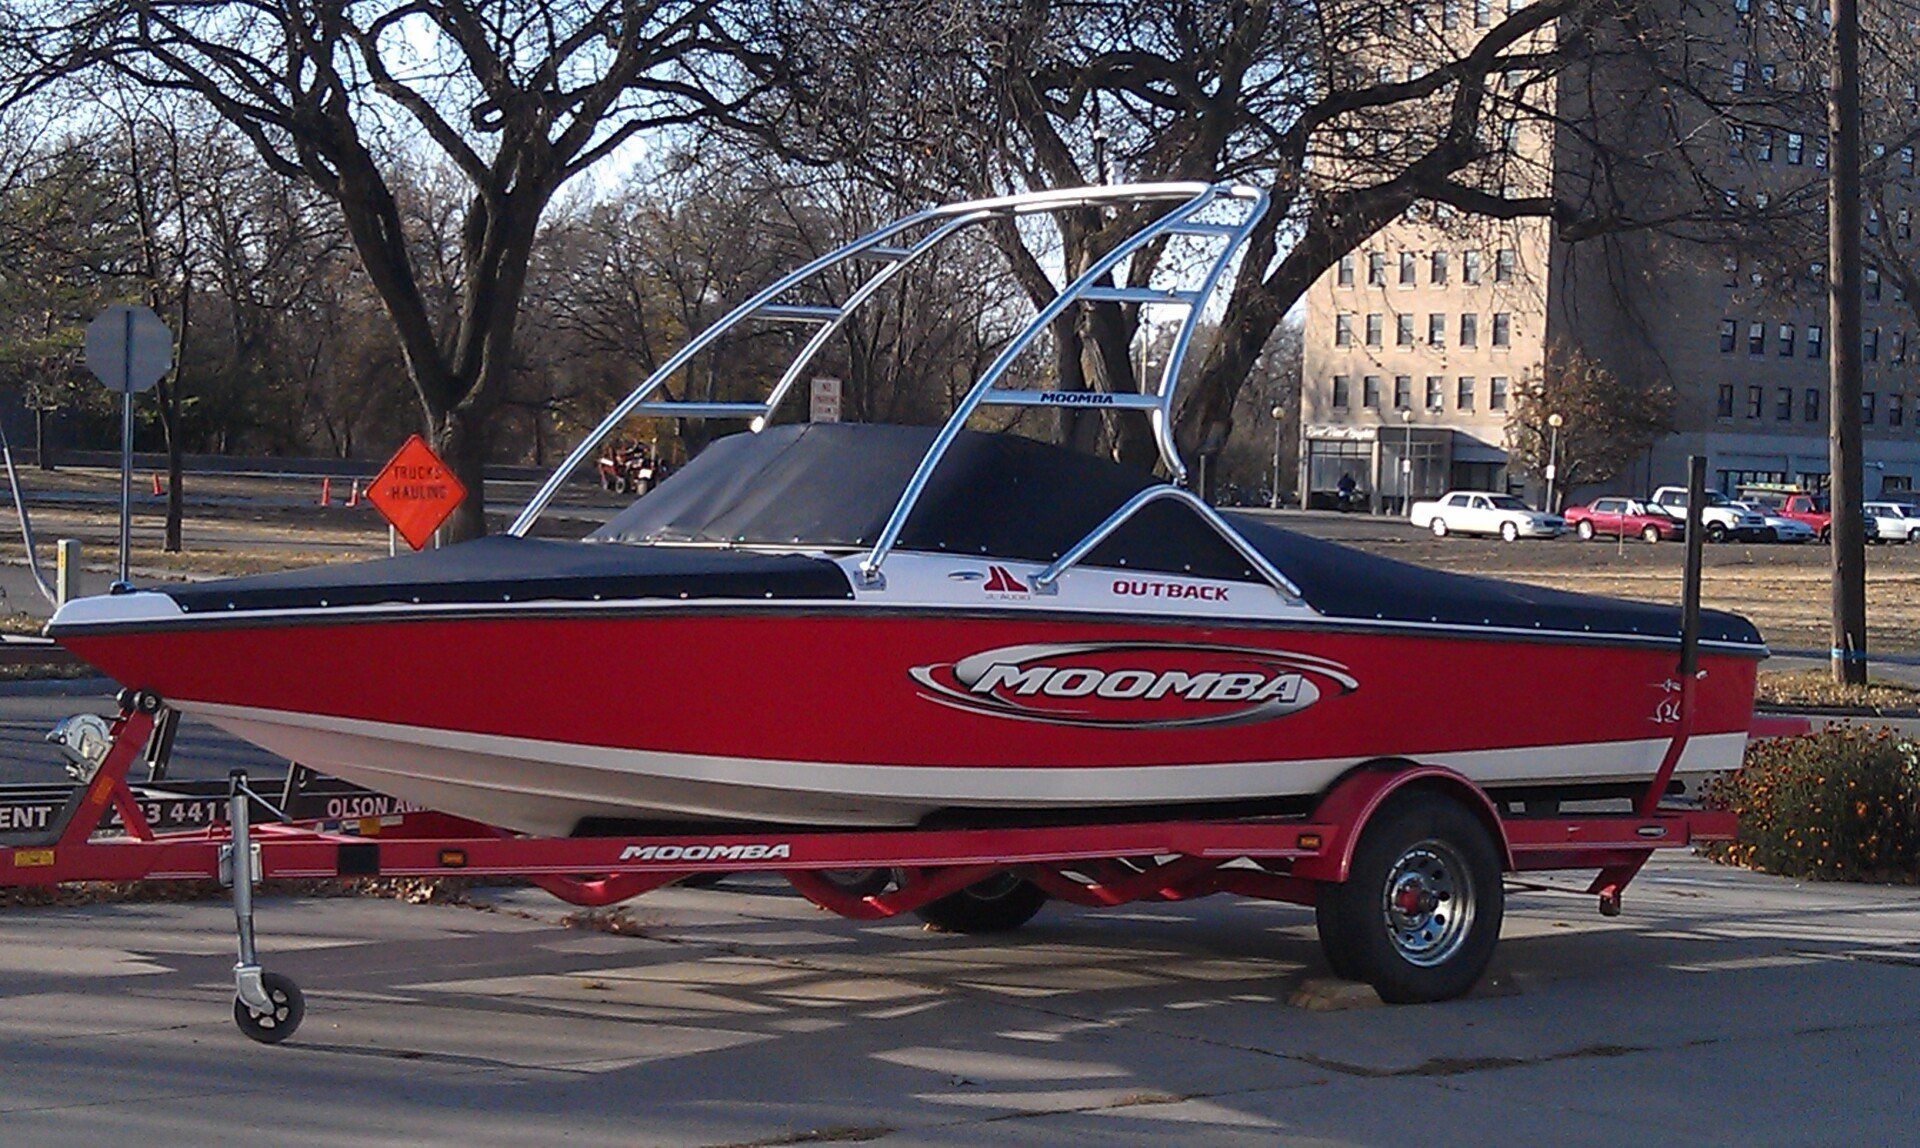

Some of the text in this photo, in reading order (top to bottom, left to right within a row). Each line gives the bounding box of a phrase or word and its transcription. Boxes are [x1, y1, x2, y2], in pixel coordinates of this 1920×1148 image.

[1040, 393, 1114, 404] MOOMBA
[394, 465, 442, 480] TRUCKS
[391, 486, 448, 500] HAULING
[1113, 580, 1230, 601] OUTBACK
[970, 663, 1304, 702] MOOMBA
[327, 797, 389, 818] OLSON
[619, 843, 791, 861] MOOMBA
